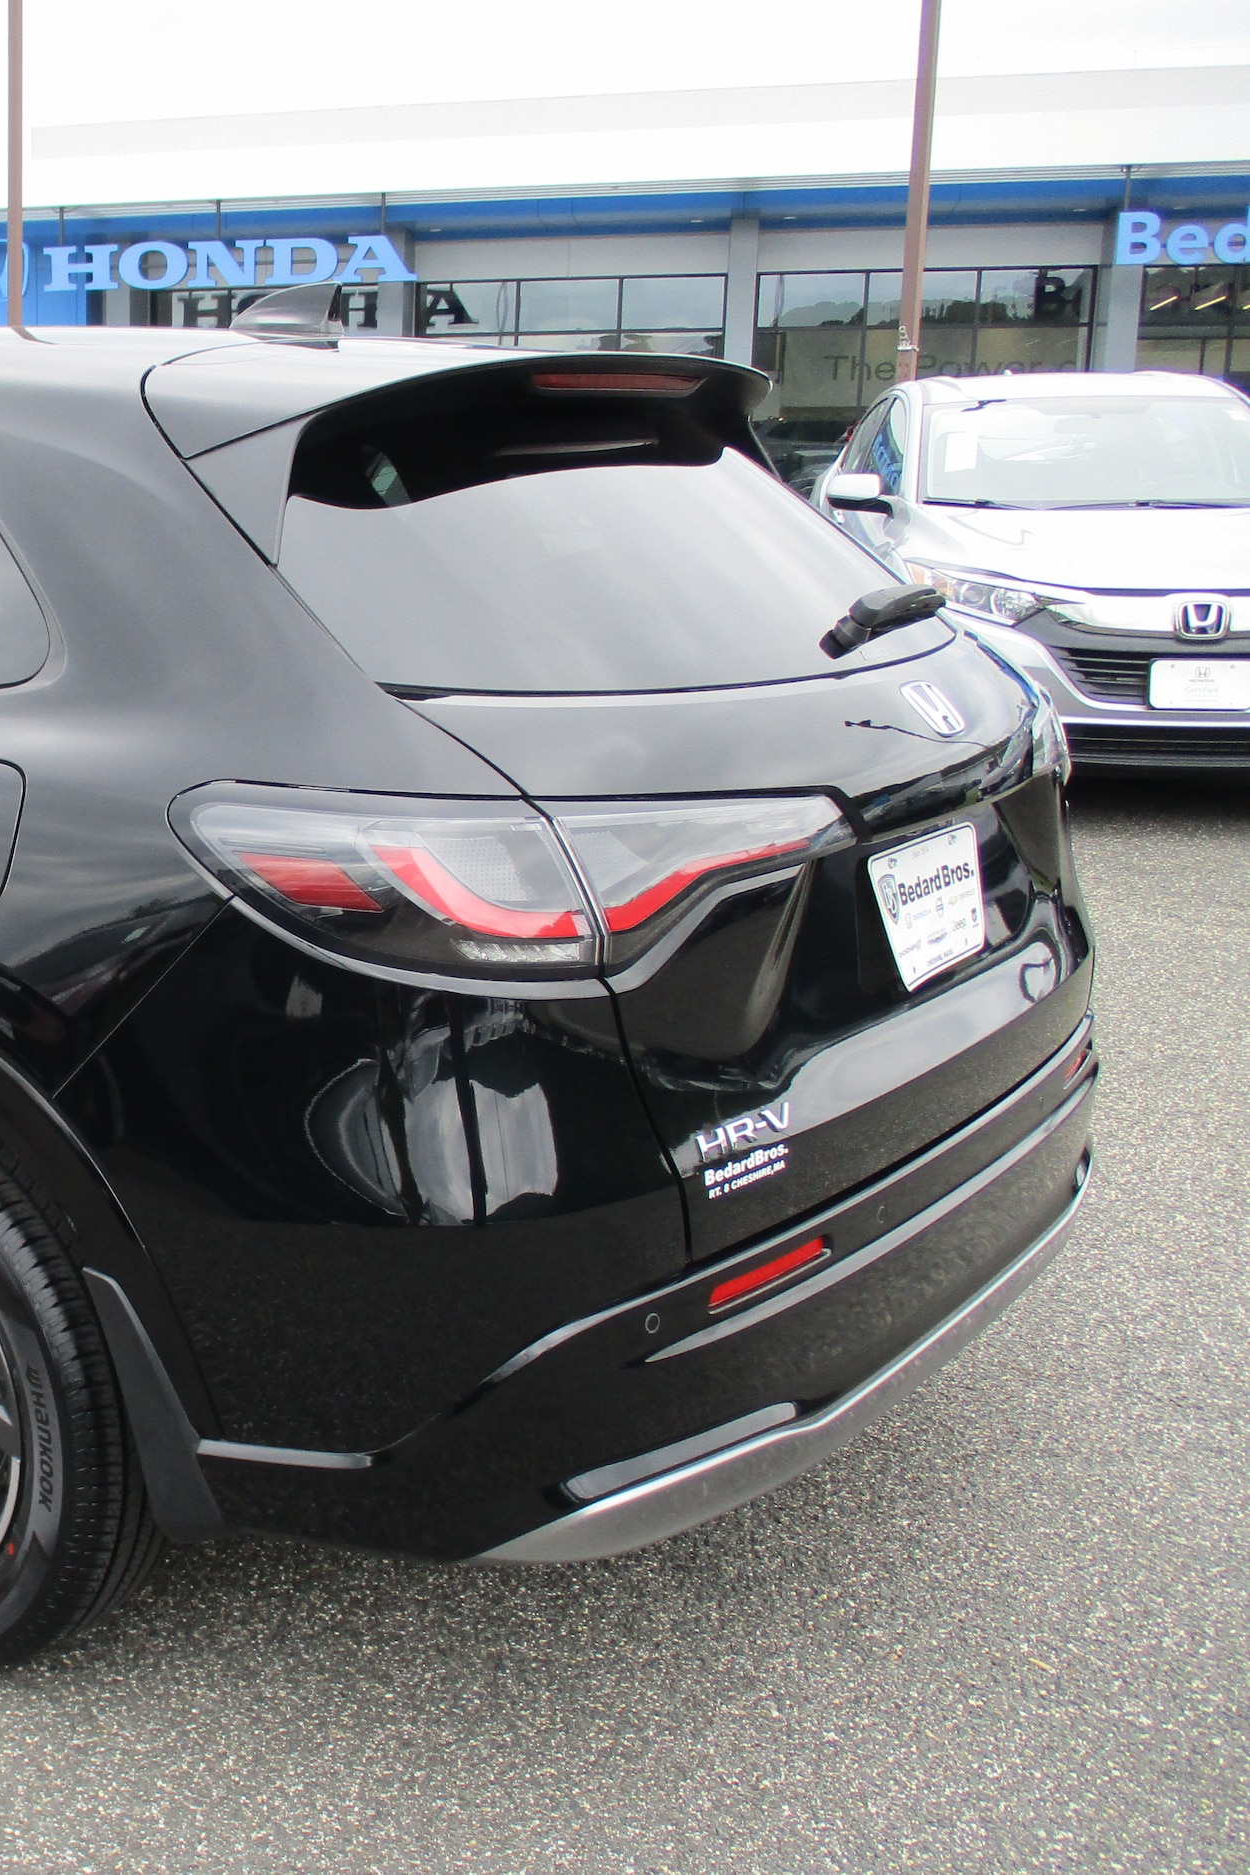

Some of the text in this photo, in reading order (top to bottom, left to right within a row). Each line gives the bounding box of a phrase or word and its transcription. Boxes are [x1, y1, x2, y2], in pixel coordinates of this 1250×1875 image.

[43, 234, 418, 292] HONDA
[1115, 204, 1250, 265] Bed
[823, 354, 896, 381] The
[695, 1101, 790, 1162] HR-V
[708, 1186, 723, 1200] RT.
[723, 1182, 730, 1193] 8
